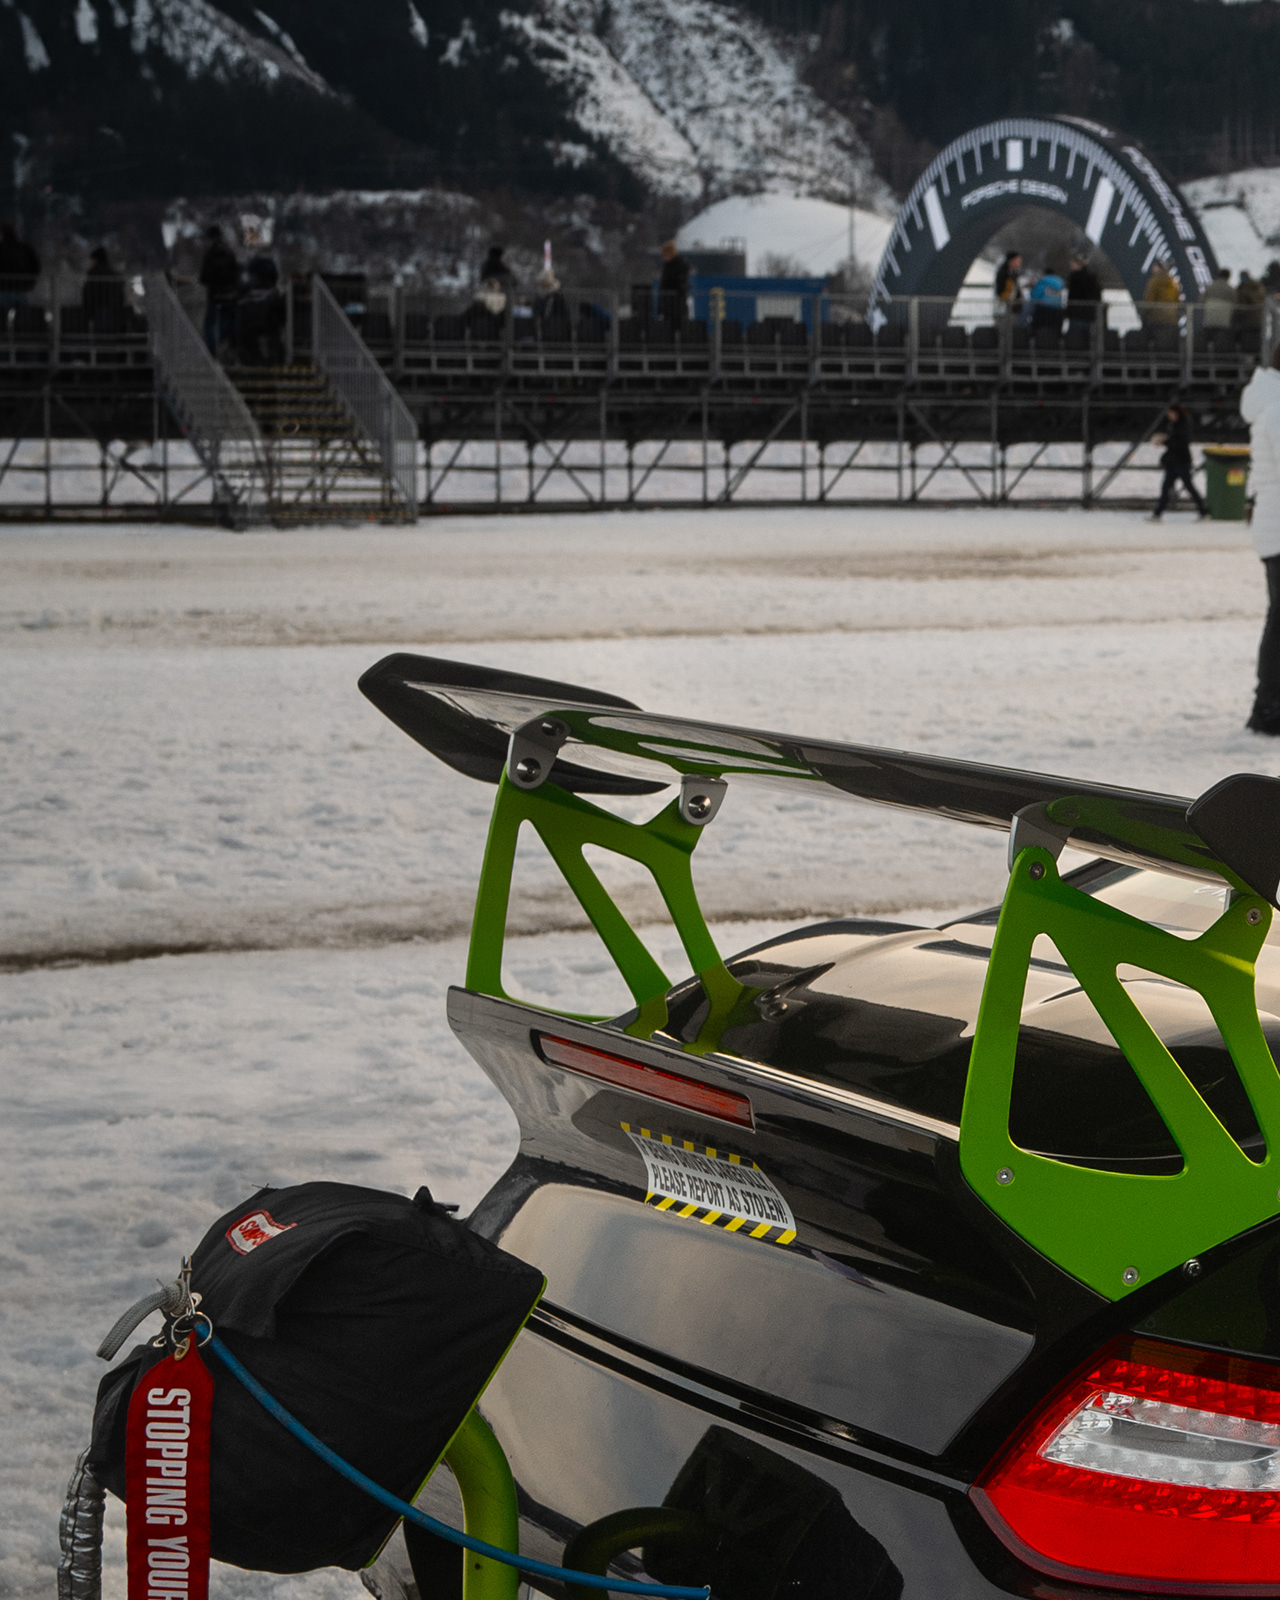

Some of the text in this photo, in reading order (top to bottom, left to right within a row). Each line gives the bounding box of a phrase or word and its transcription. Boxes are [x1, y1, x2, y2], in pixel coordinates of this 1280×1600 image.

[652, 1163, 789, 1224] PLEASE REPORT AS STOLEN!
[145, 1388, 191, 1526] STOPPING
